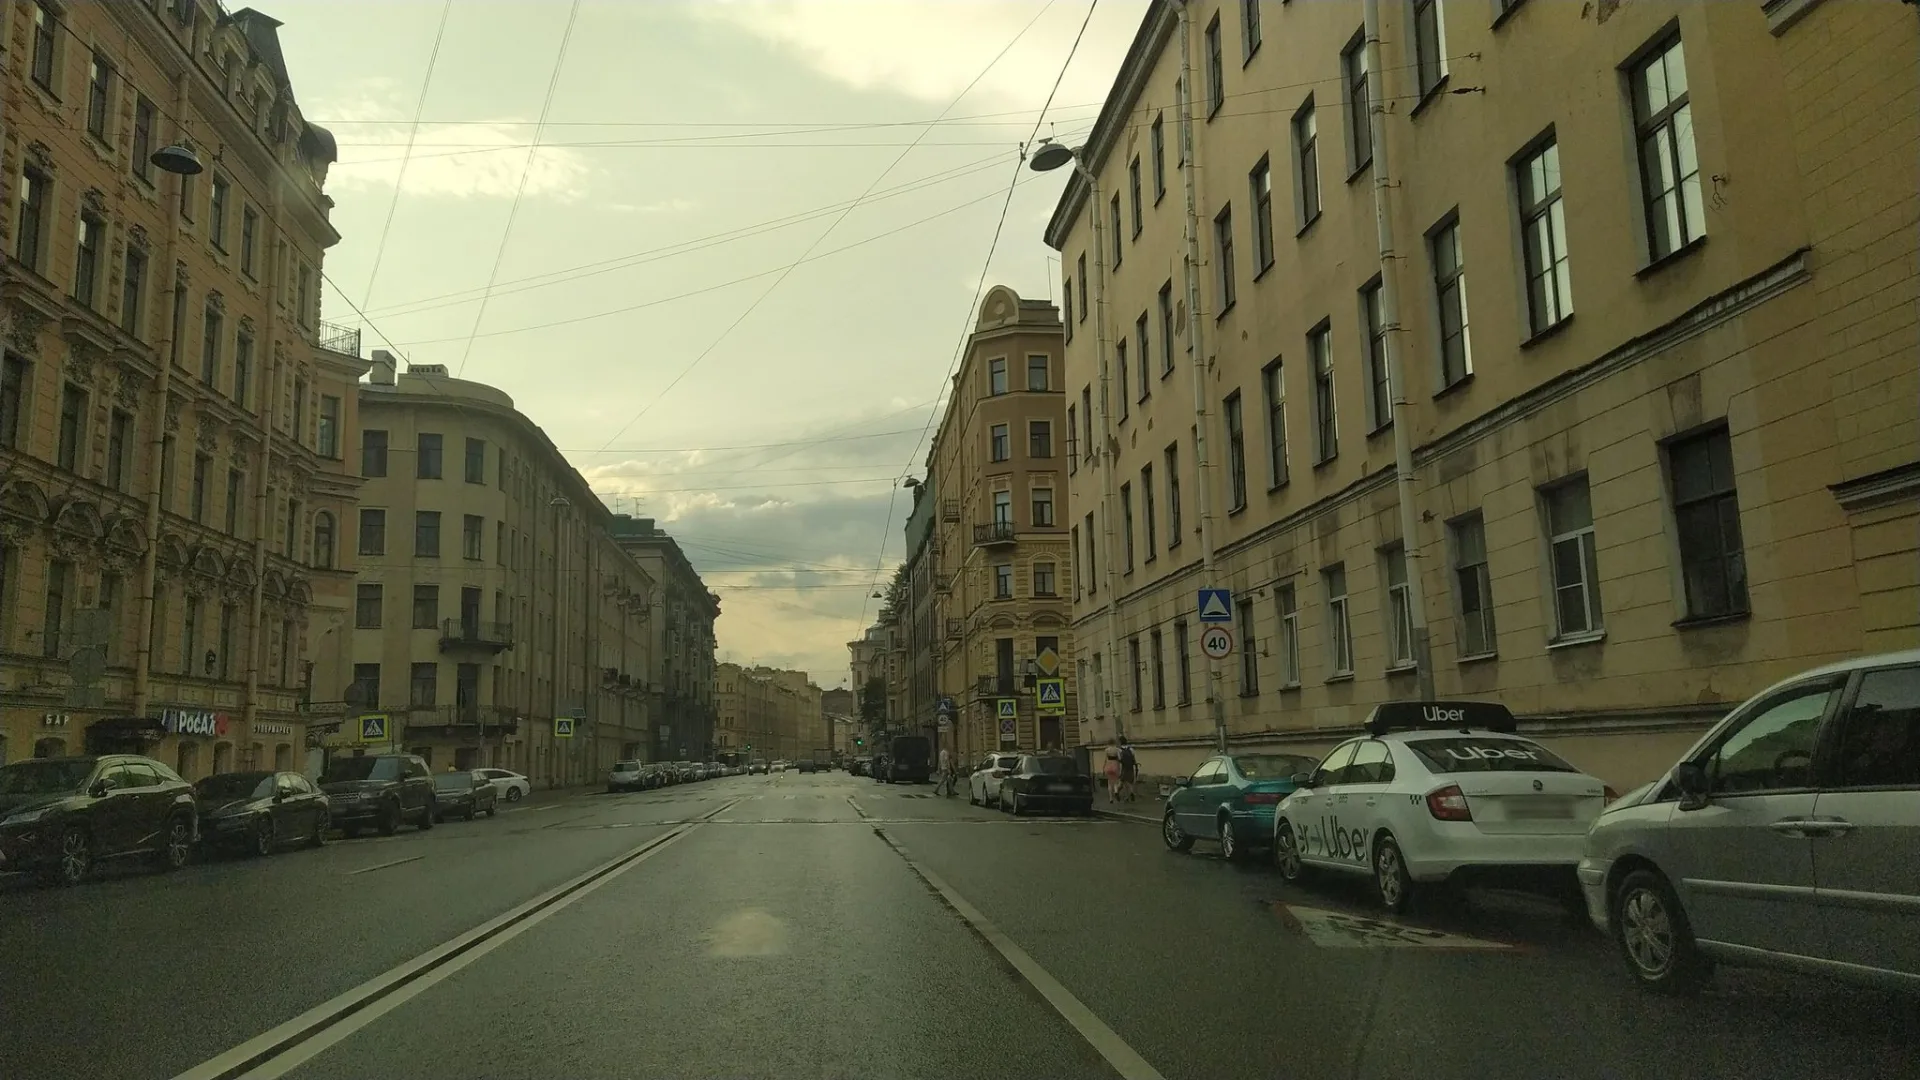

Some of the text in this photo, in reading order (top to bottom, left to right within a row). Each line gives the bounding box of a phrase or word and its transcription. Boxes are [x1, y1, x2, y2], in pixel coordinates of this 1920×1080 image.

[1207, 636, 1227, 650] 40
[45, 714, 70, 725] БАР
[1422, 705, 1465, 722] Uber
[1445, 746, 1539, 760] Uber
[1321, 815, 1370, 862] Uber
